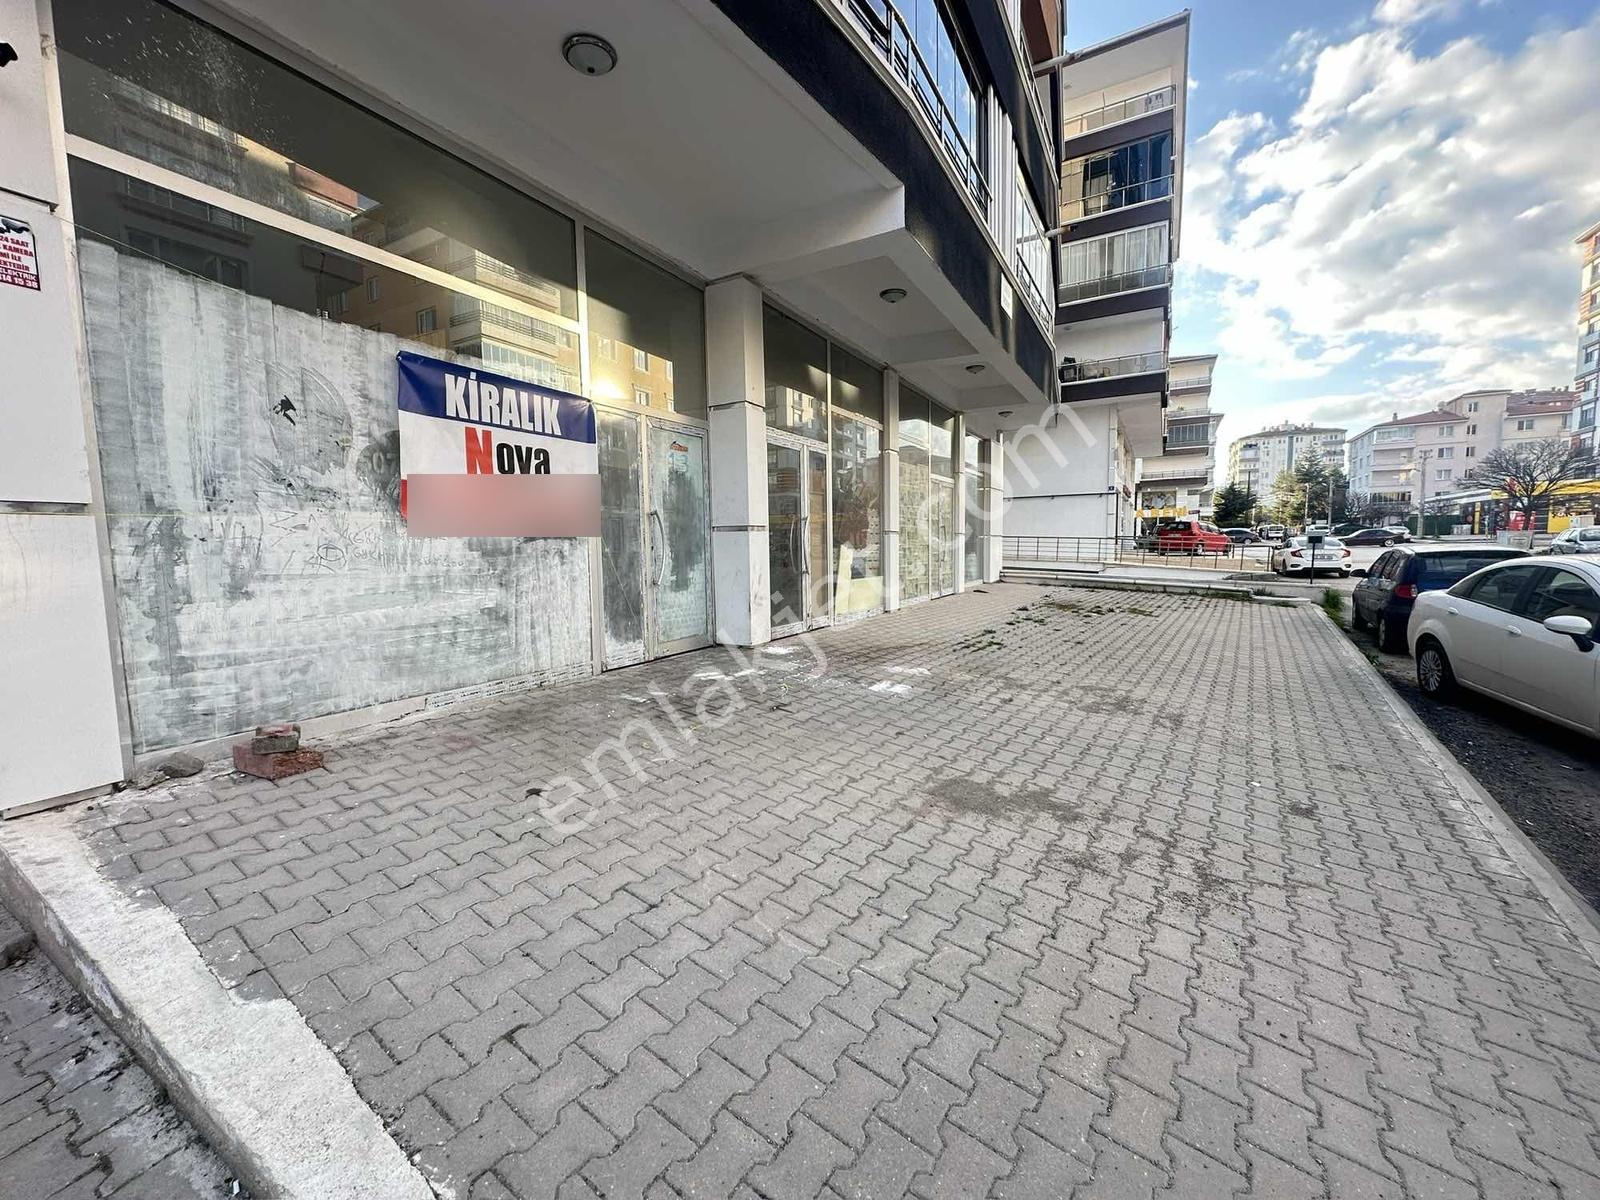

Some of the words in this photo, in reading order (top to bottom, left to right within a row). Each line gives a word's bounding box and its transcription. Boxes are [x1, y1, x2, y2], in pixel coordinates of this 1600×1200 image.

[2, 244, 34, 257] KAMERA
[10, 238, 29, 248] SAAT
[444, 371, 562, 436] KİRALIK
[464, 426, 551, 475] Nova
